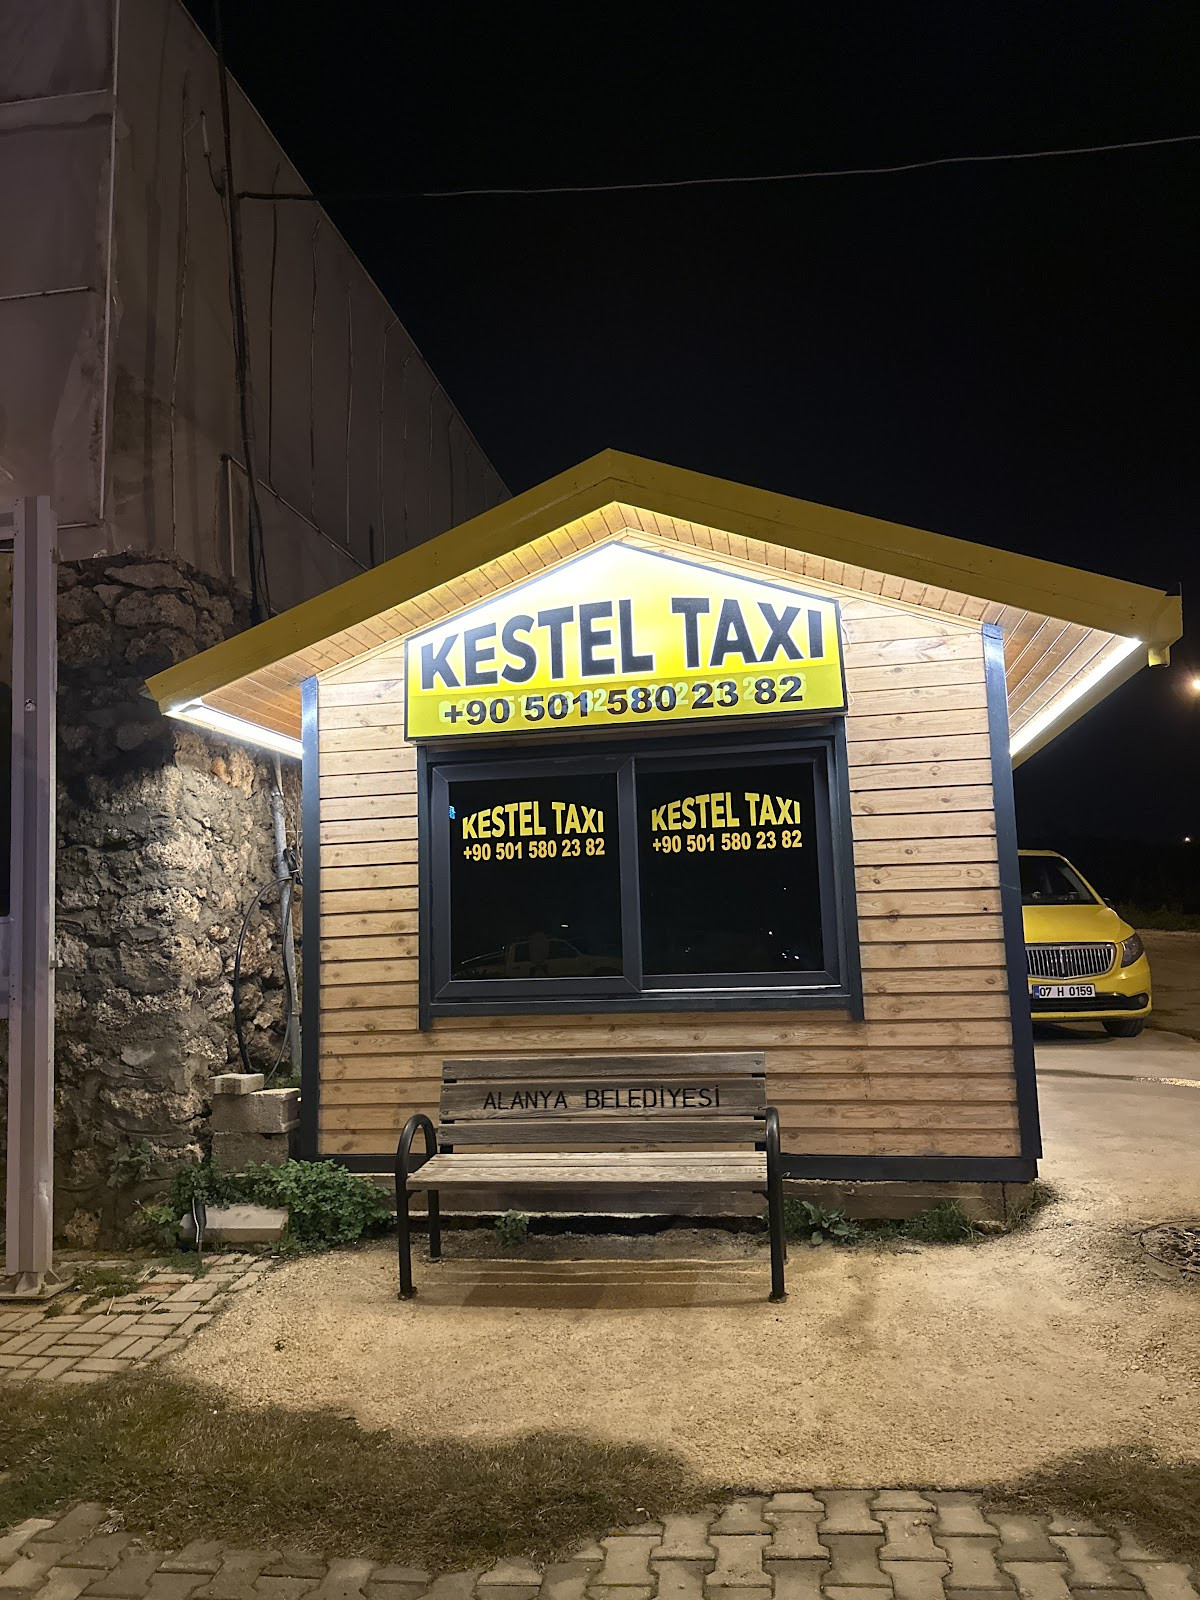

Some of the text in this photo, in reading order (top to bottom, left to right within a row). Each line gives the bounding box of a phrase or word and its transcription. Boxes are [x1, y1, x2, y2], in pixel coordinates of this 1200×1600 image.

[421, 597, 825, 689] KESTEL TAXI
[444, 698, 510, 726] +90
[524, 692, 589, 722] 501
[607, 685, 677, 715] 580
[691, 681, 739, 710] 23
[753, 676, 803, 705] 82
[462, 801, 604, 840] KESTEL TAXI
[651, 792, 801, 832] KESTEL TAXI
[463, 837, 606, 862] +90 501 580 23 82
[652, 829, 803, 854] +90 501 580 23 82
[1040, 987, 1052, 997] 07
[1057, 986, 1065, 997] H
[1069, 986, 1093, 996] 0159
[483, 1084, 721, 1111] ALANYA BELEDİYESİ
